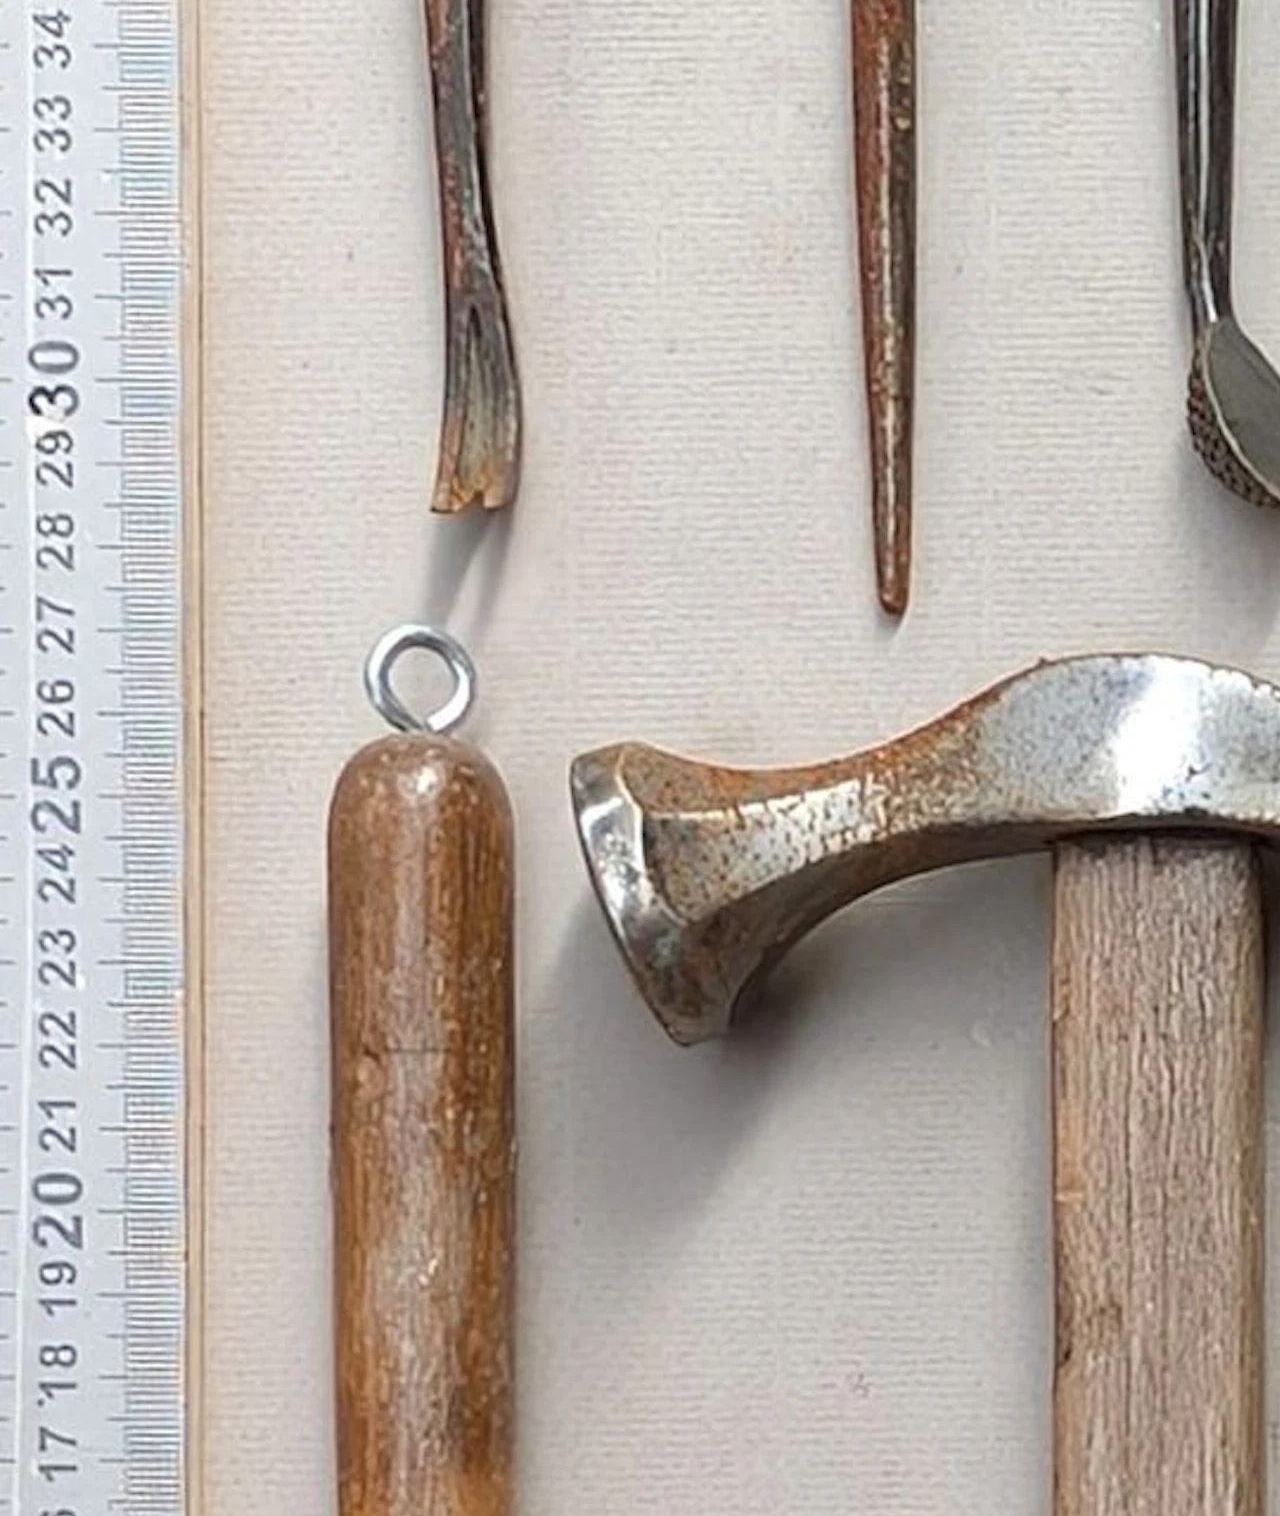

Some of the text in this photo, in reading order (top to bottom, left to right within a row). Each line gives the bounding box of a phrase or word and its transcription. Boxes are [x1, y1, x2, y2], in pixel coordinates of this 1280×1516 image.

[31, 9, 72, 70] 34
[32, 95, 73, 153] 33
[33, 178, 74, 237] 32
[33, 267, 74, 321] 31
[26, 340, 80, 418] 30
[34, 429, 75, 489] 29
[35, 513, 75, 572] 28
[35, 595, 76, 654] 27
[35, 679, 76, 738] 26
[29, 755, 82, 835] 25
[35, 843, 76, 905] 24
[37, 928, 77, 988] 23
[37, 1010, 77, 1070] 22
[37, 1100, 77, 1154] 21
[30, 1172, 84, 1250] 20
[37, 1260, 78, 1317] 19
[37, 1344, 78, 1400] 18
[37, 1426, 79, 1483] 17
